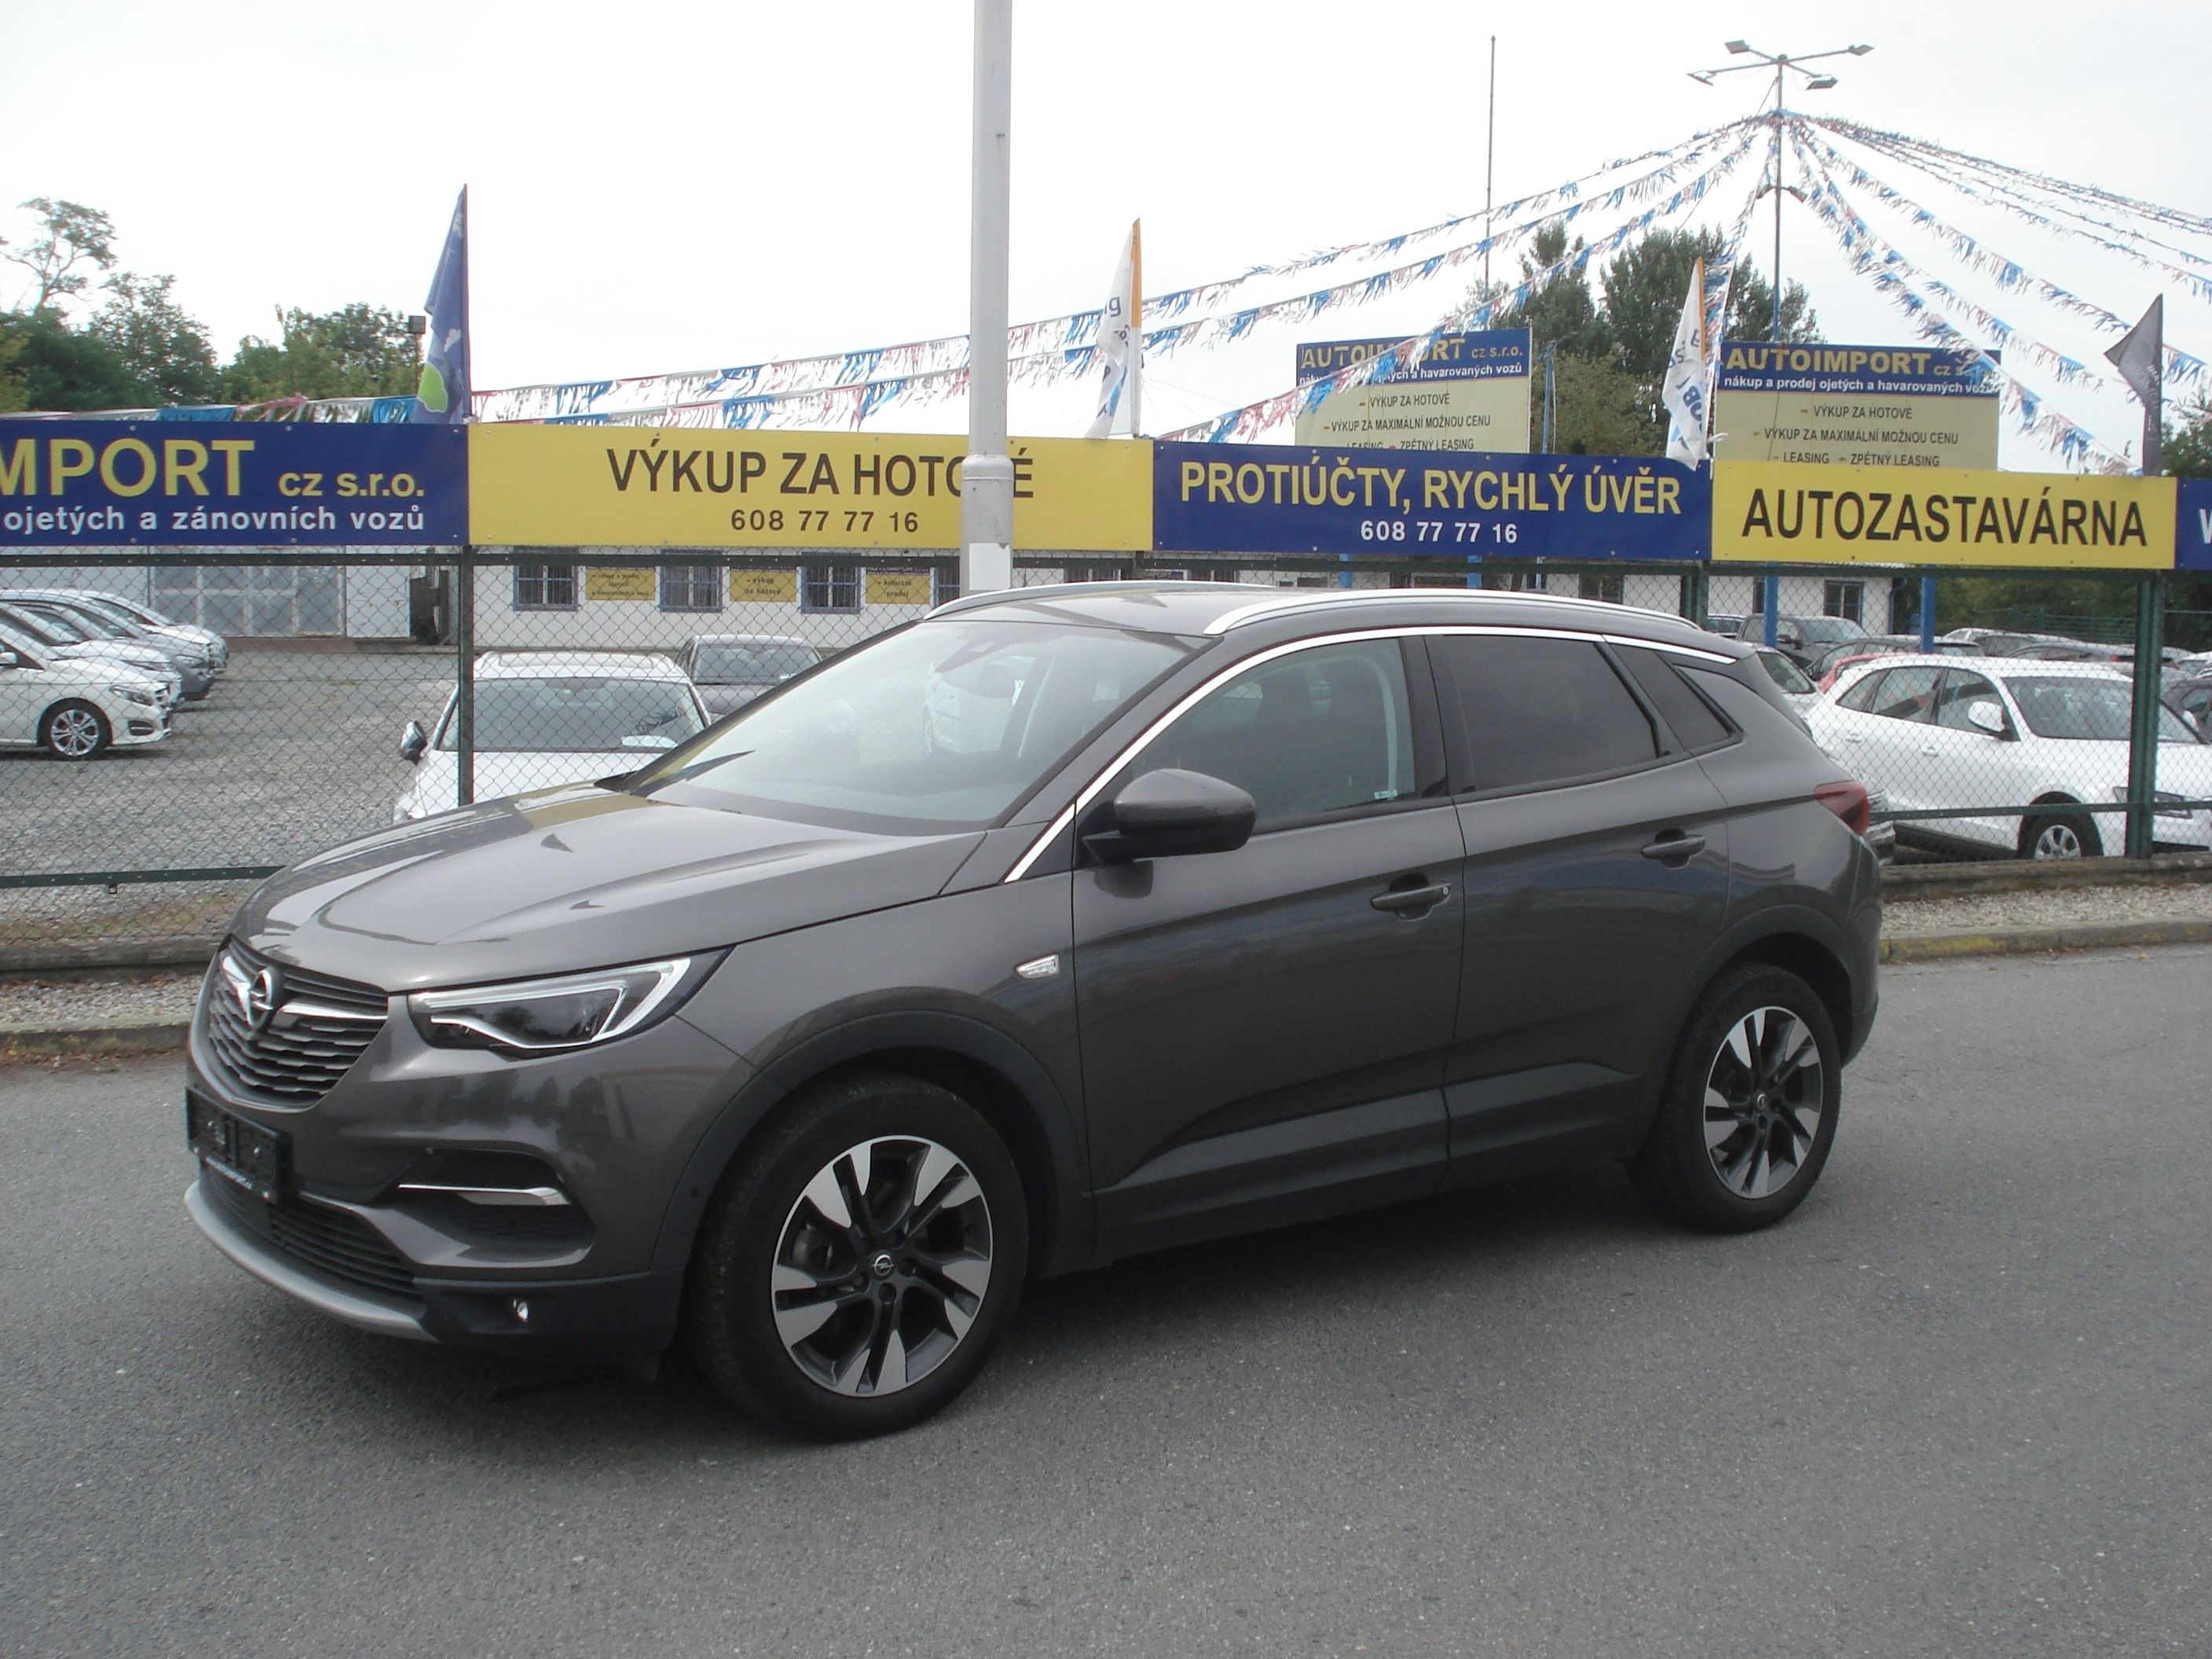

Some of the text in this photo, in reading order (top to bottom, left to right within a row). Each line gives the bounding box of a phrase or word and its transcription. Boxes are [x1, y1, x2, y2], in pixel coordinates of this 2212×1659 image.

[1301, 339, 1466, 369] AUTOIRT
[1490, 346, 1523, 357] s.r.o.
[1725, 347, 1932, 375] AUTOIMPORT
[1933, 364, 1951, 376] cz
[1421, 364, 1493, 379] havarovaných
[1496, 361, 1522, 374] vozů
[1724, 375, 1763, 390] nákup
[1766, 378, 1773, 387] a
[1777, 377, 1816, 391] prodej
[1819, 378, 1863, 392] ojetých
[1866, 381, 1874, 390] a
[1877, 380, 1963, 395] havarovaných
[1370, 393, 1398, 408] VÝKUP
[1400, 395, 1412, 407] ZA
[1814, 405, 1850, 418] VÝKUP
[1852, 406, 1866, 418] ZA
[1331, 418, 1360, 432] VÝKUP
[1361, 419, 1373, 430] ZA
[1375, 415, 1423, 430] MAXIMÁLNÍ
[1466, 415, 1491, 427] CENU
[1436, 438, 1474, 451] LEASING
[1765, 427, 1800, 441] VÝKUP
[1803, 428, 1817, 441] ZA
[1820, 428, 1879, 442] MAXIMÁLNÍ
[1930, 432, 1958, 445] CENU
[0, 438, 425, 497] MPORT cz s.r.o.
[606, 438, 1034, 498] VÝKUP ZA HOTOÉ
[1783, 451, 1829, 464] LEASING
[1894, 452, 1940, 467] LEASING
[1181, 456, 1682, 515] PROTIÚČTY, RYCHLÝ ÚVĚR
[4, 504, 424, 536] ojetých a zánovních vozů
[731, 509, 918, 533] 608 77 77 16
[1741, 485, 2148, 548] AUTOZASTAVÁRNA
[1360, 520, 1518, 544] 608 77 77 16
